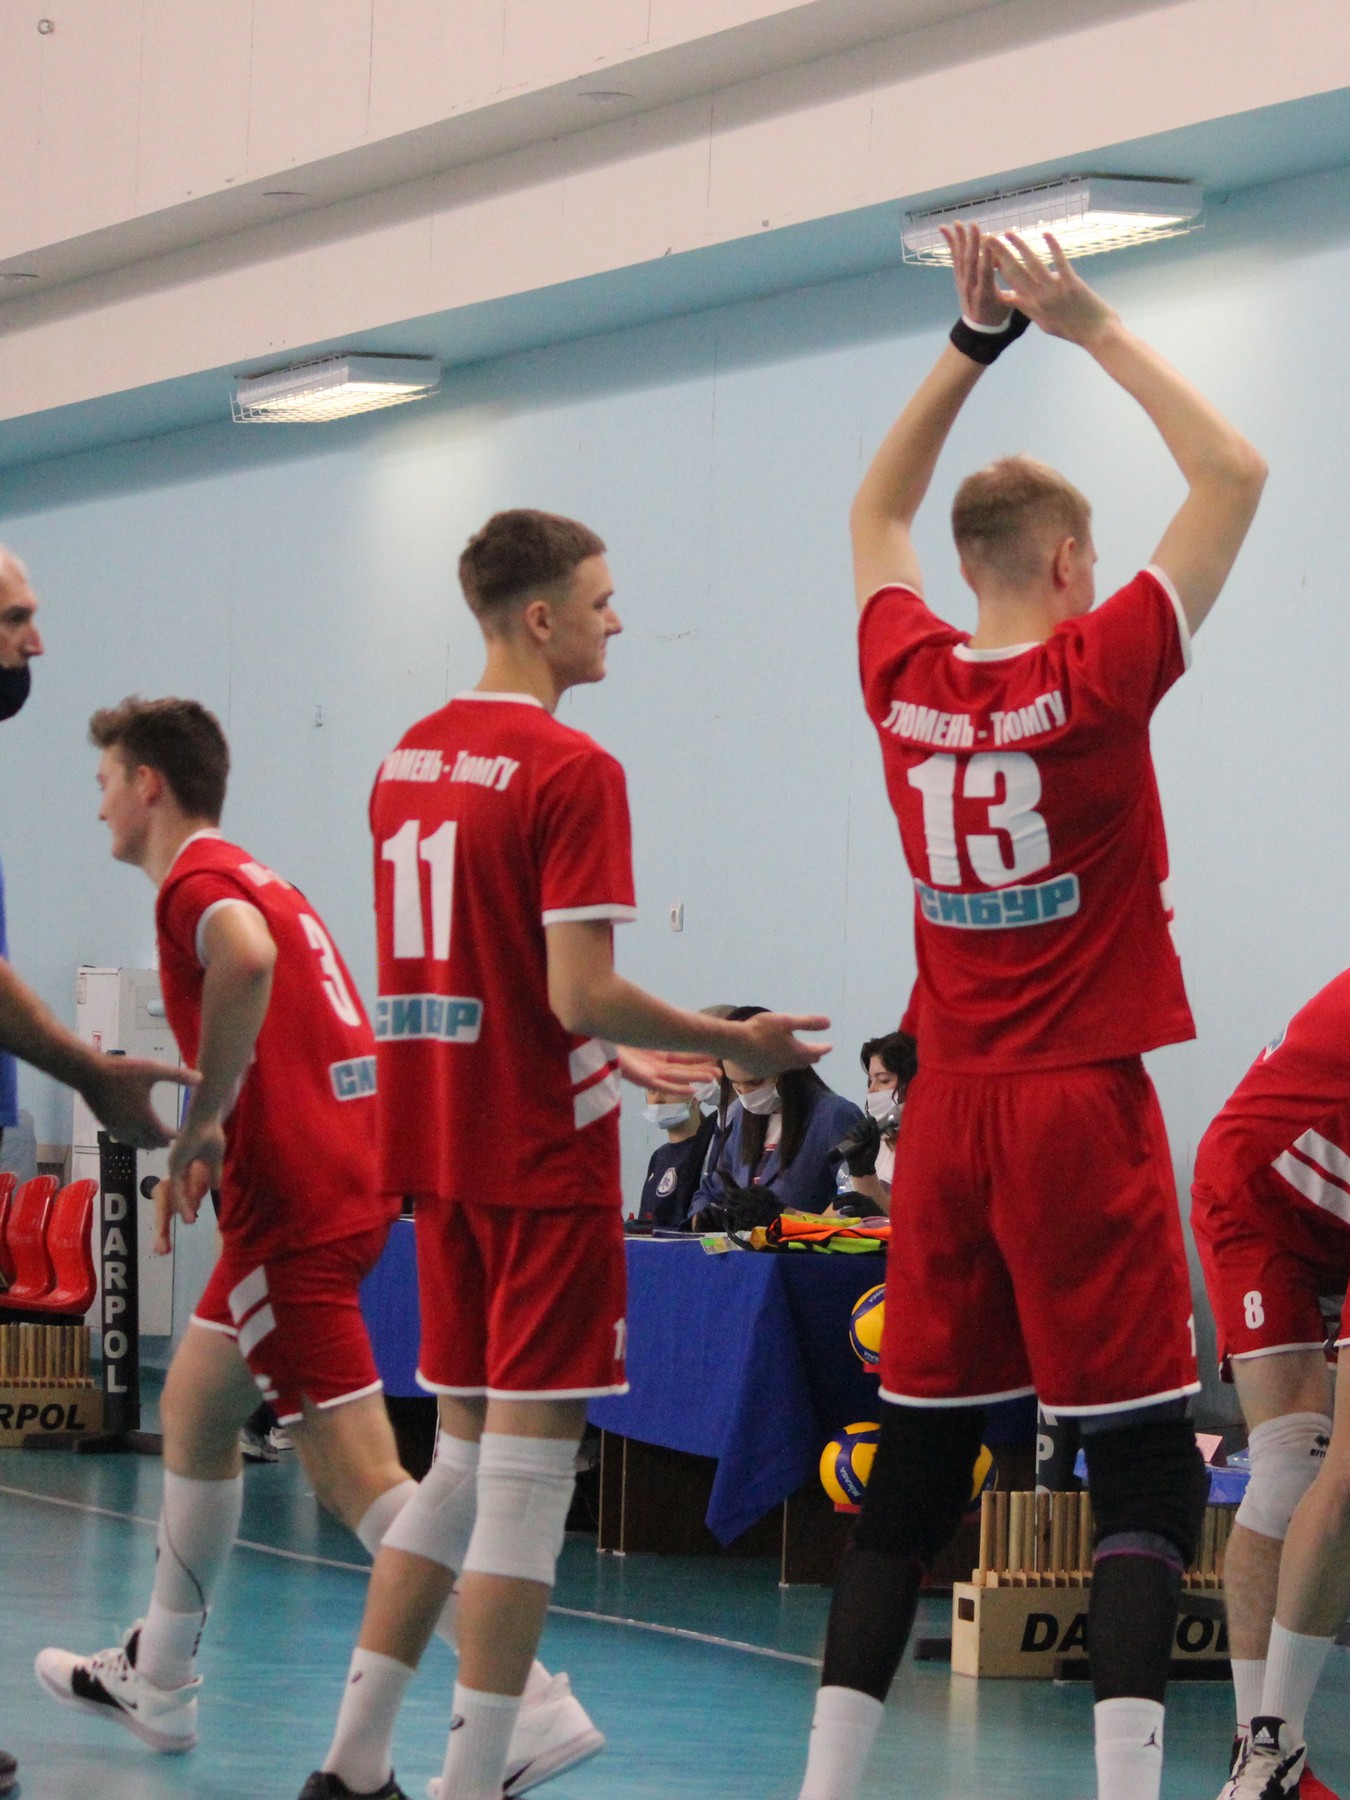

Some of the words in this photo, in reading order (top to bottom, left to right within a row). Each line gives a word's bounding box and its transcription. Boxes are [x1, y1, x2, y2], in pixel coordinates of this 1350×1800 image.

[907, 751, 1052, 888] 13
[381, 819, 458, 961] 11
[298, 913, 362, 1027] 3
[104, 1193, 128, 1393] DARPOL
[1243, 1290, 1265, 1330] 8
[0, 1404, 86, 1431] RPOL
